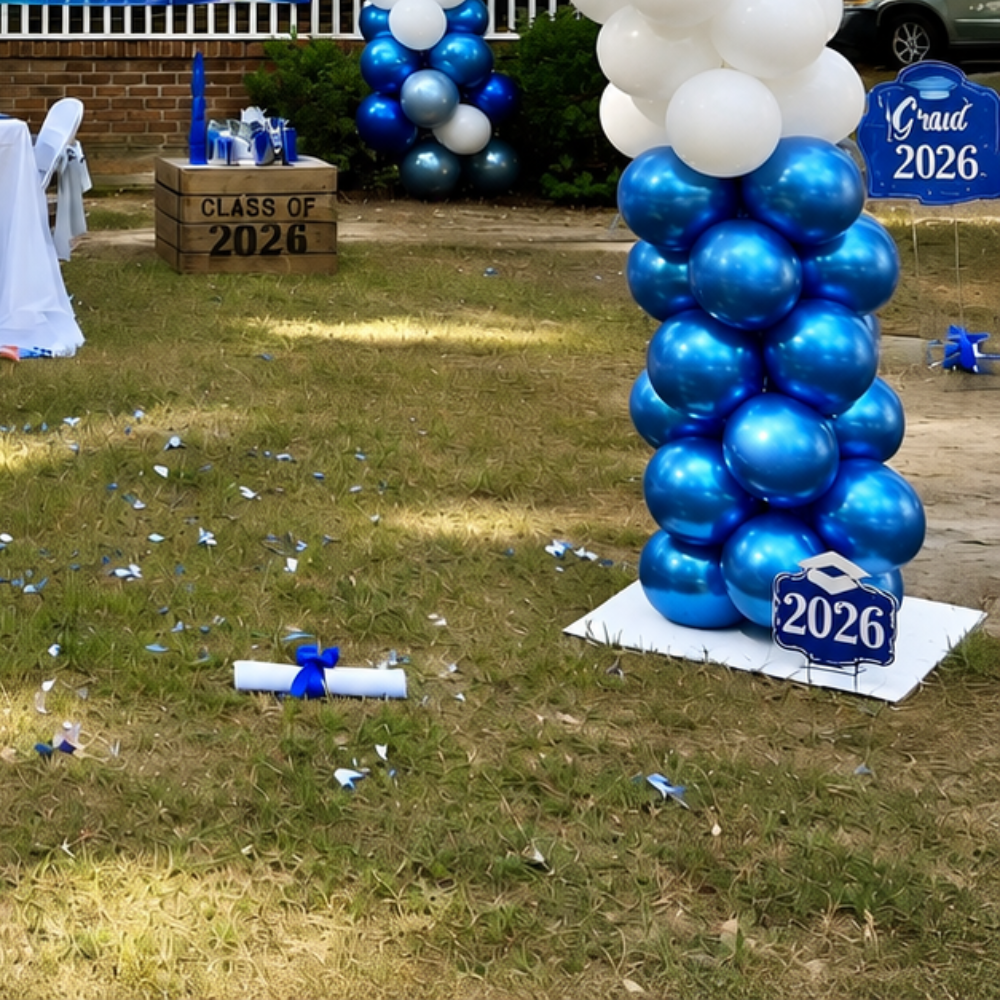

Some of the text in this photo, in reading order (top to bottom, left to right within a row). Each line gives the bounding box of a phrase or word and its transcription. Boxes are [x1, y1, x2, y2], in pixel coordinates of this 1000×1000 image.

[893, 144, 979, 180] 2026
[201, 197, 316, 218] CLASS OF
[209, 224, 308, 257] 2026
[782, 592, 885, 649] 2026
